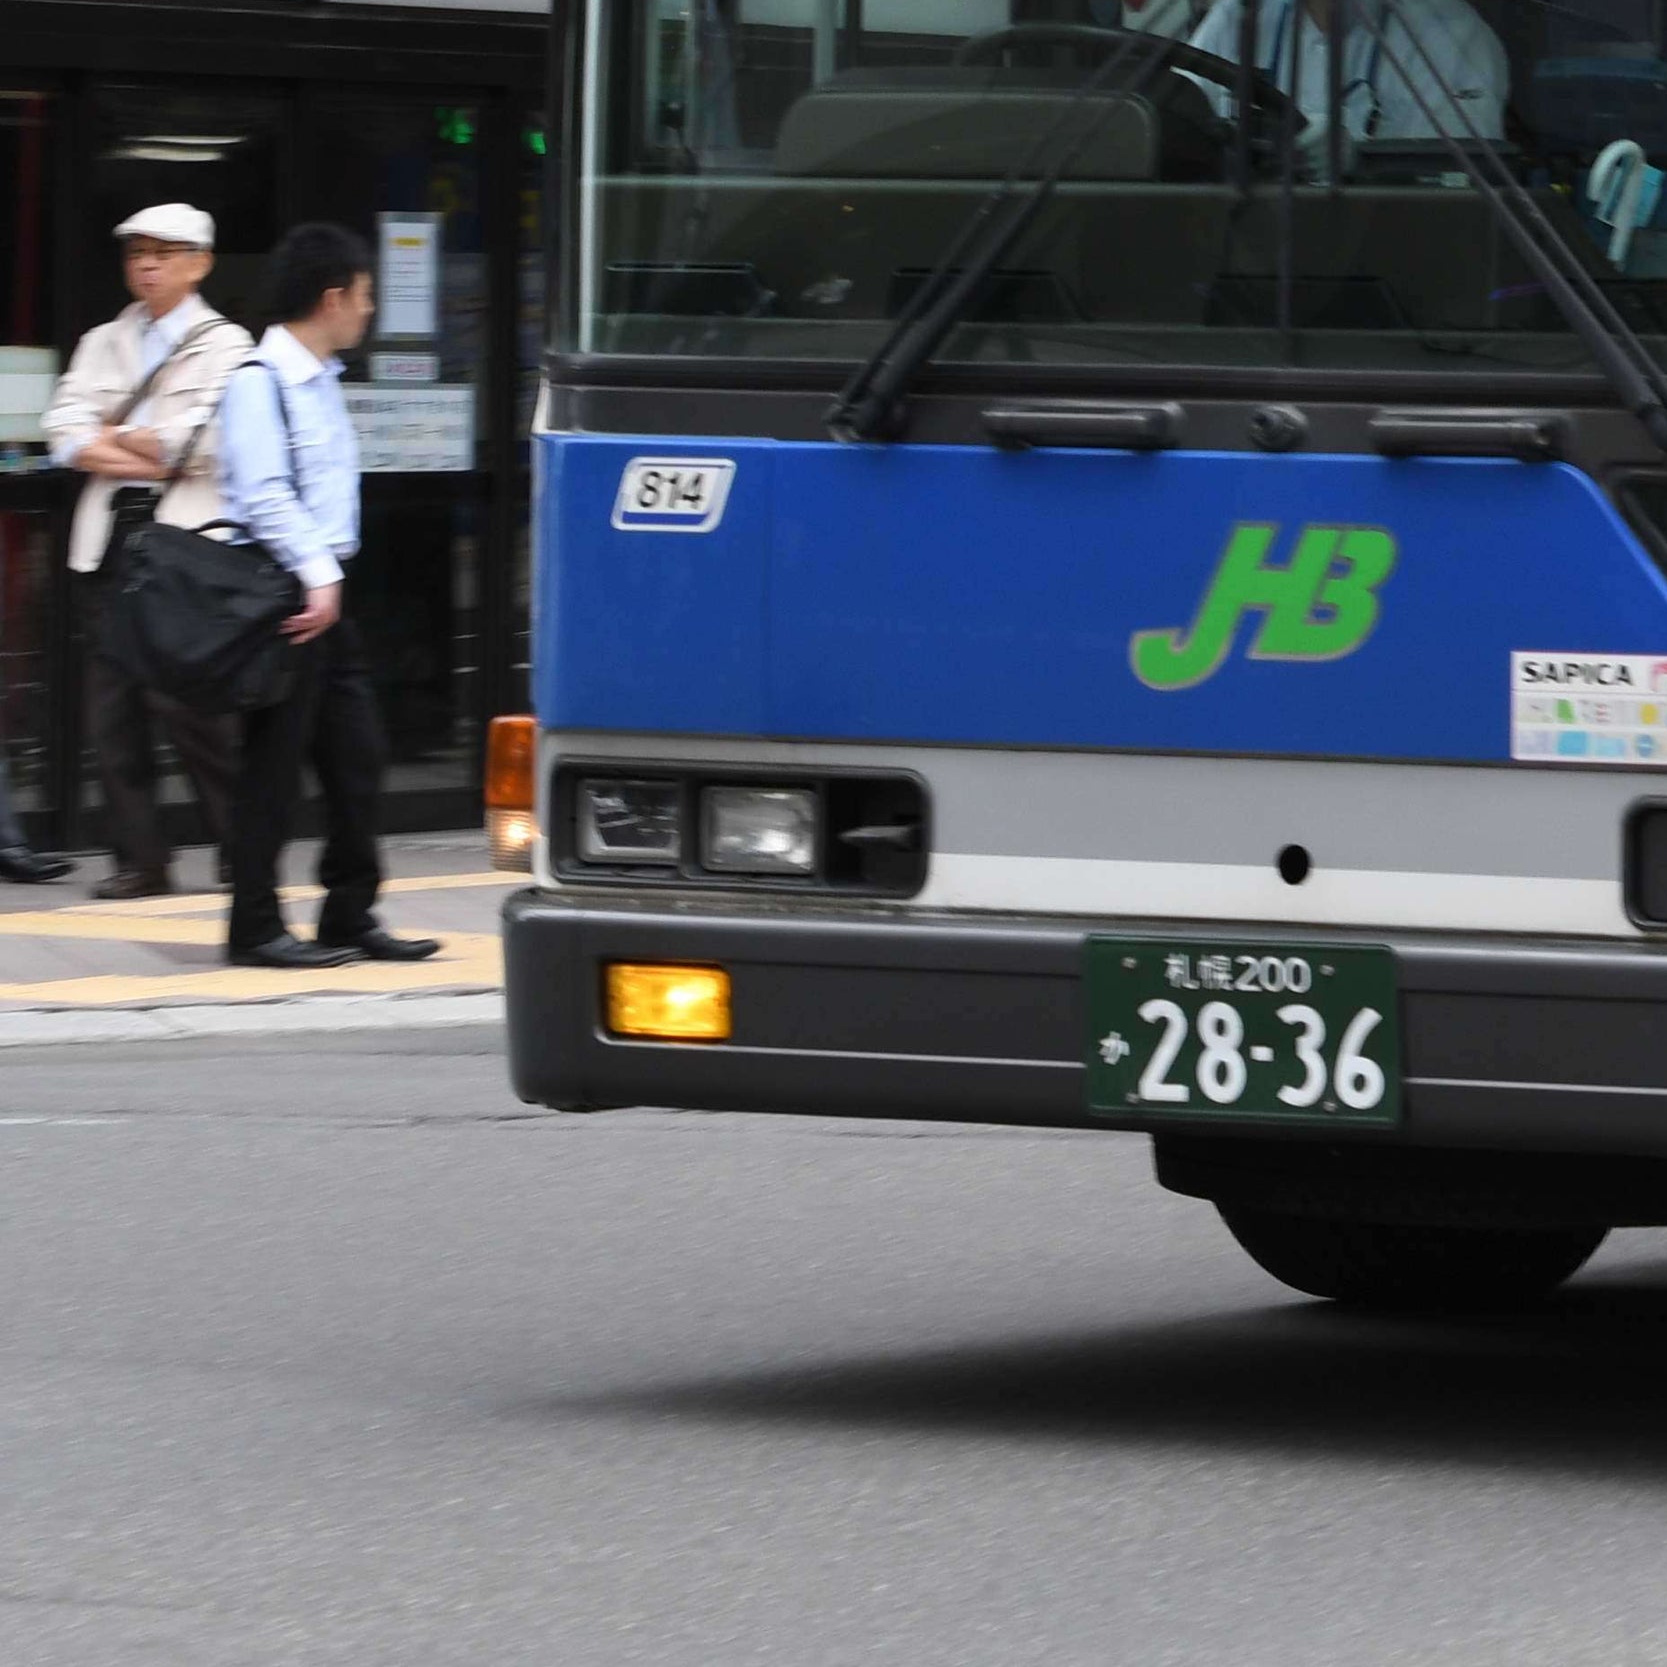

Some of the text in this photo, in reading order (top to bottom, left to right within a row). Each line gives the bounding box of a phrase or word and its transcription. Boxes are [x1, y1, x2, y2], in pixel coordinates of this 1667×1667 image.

[637, 471, 704, 509] 814
[1521, 660, 1636, 686] SAPICA
[1137, 998, 1386, 1110] 28-36
